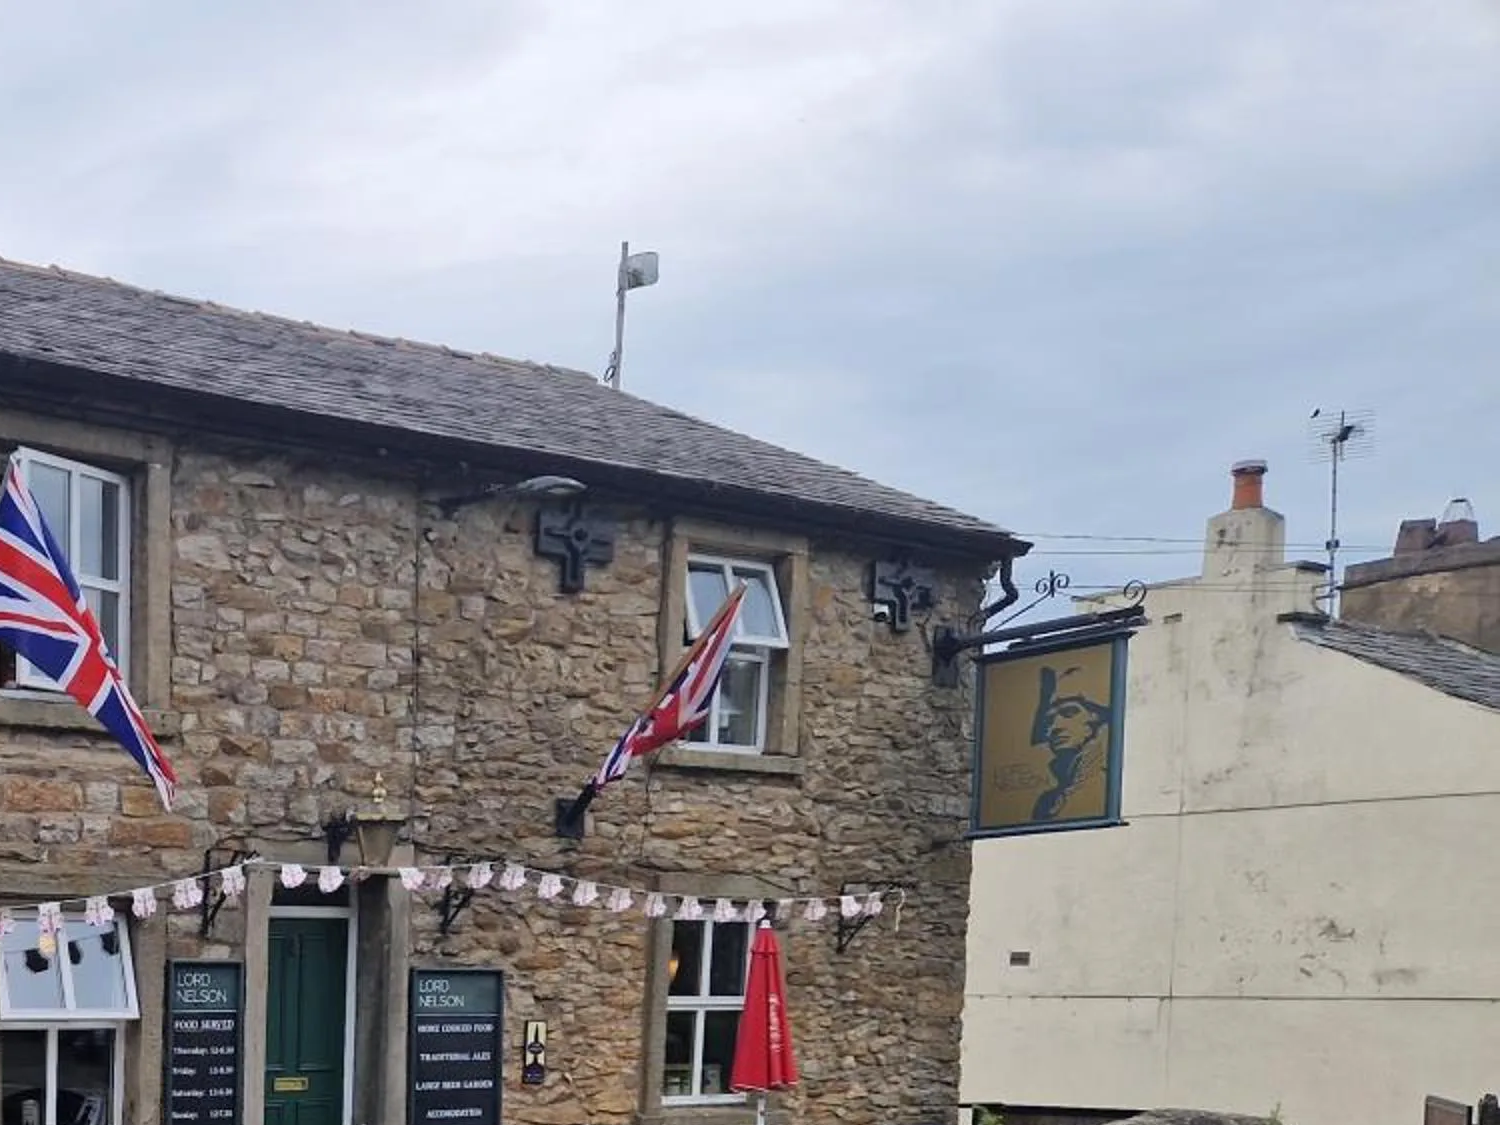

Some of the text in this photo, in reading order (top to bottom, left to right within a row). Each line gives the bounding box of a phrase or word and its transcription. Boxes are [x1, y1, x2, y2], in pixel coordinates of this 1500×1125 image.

[176, 973, 212, 987] LORD
[418, 979, 450, 994] LORD
[176, 989, 228, 1004] NELSON
[418, 995, 466, 1008] NELSON
[174, 1019, 235, 1032] FOOD SERVED
[417, 1023, 494, 1033] HOME COOKED FOOD
[419, 1051, 492, 1063] TRADITIONAL ALES
[463, 1079, 493, 1090] GARDEN
